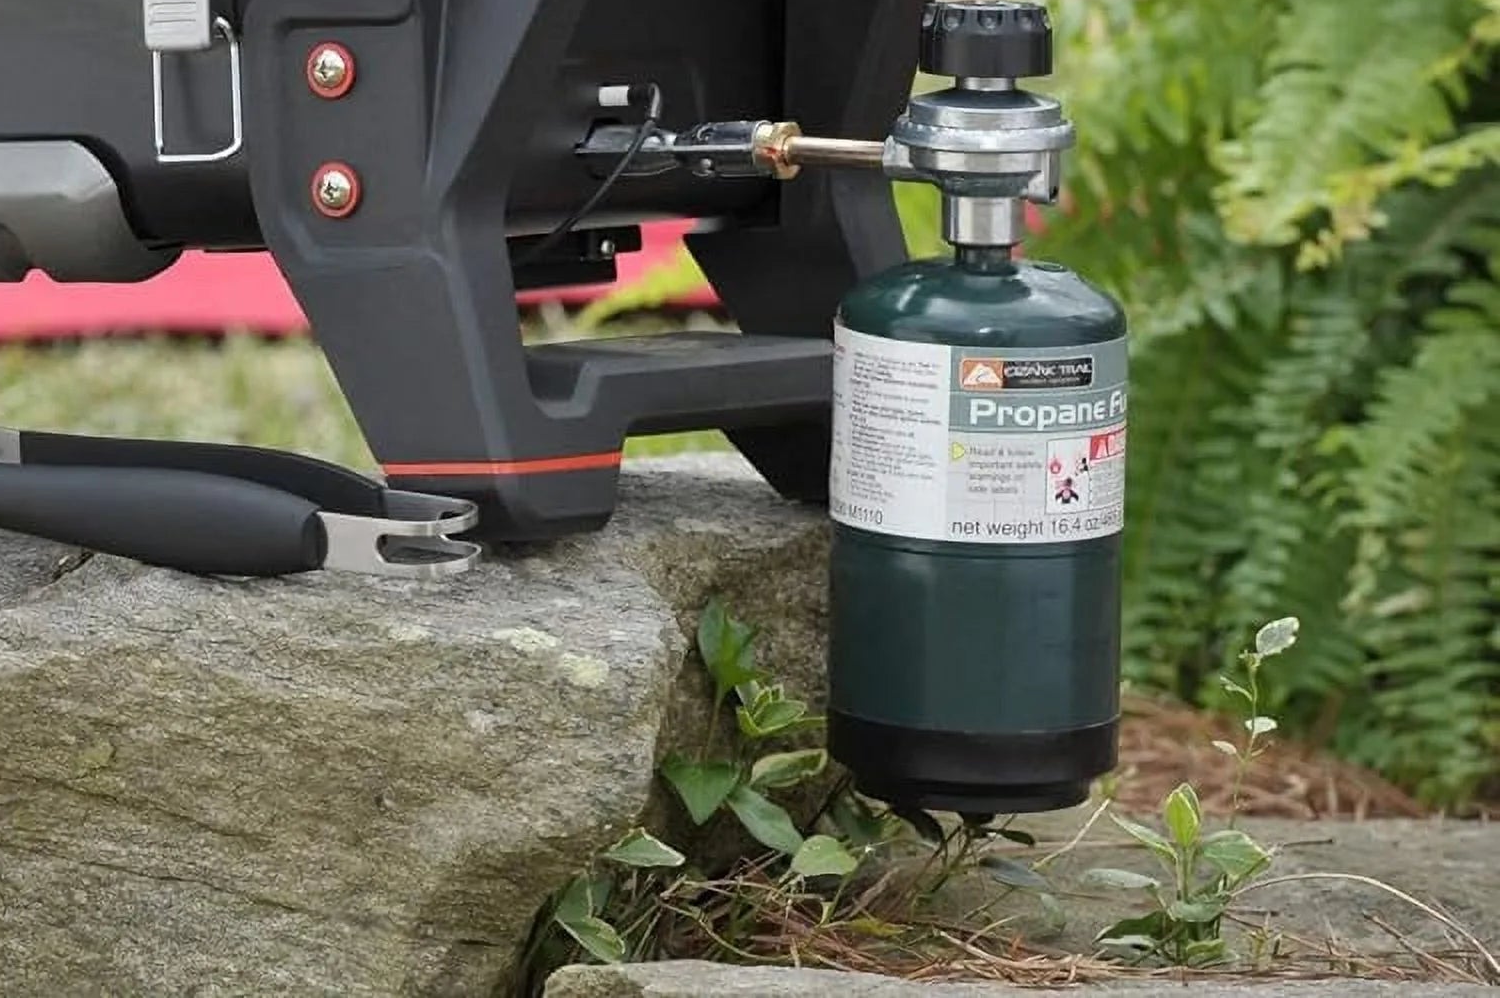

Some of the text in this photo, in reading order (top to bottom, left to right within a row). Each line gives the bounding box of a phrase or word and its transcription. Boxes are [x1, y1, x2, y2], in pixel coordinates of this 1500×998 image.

[970, 399, 1106, 431] Propane
[952, 520, 980, 535] net
[987, 519, 1043, 539] weight
[1052, 517, 1081, 535] 16.4
